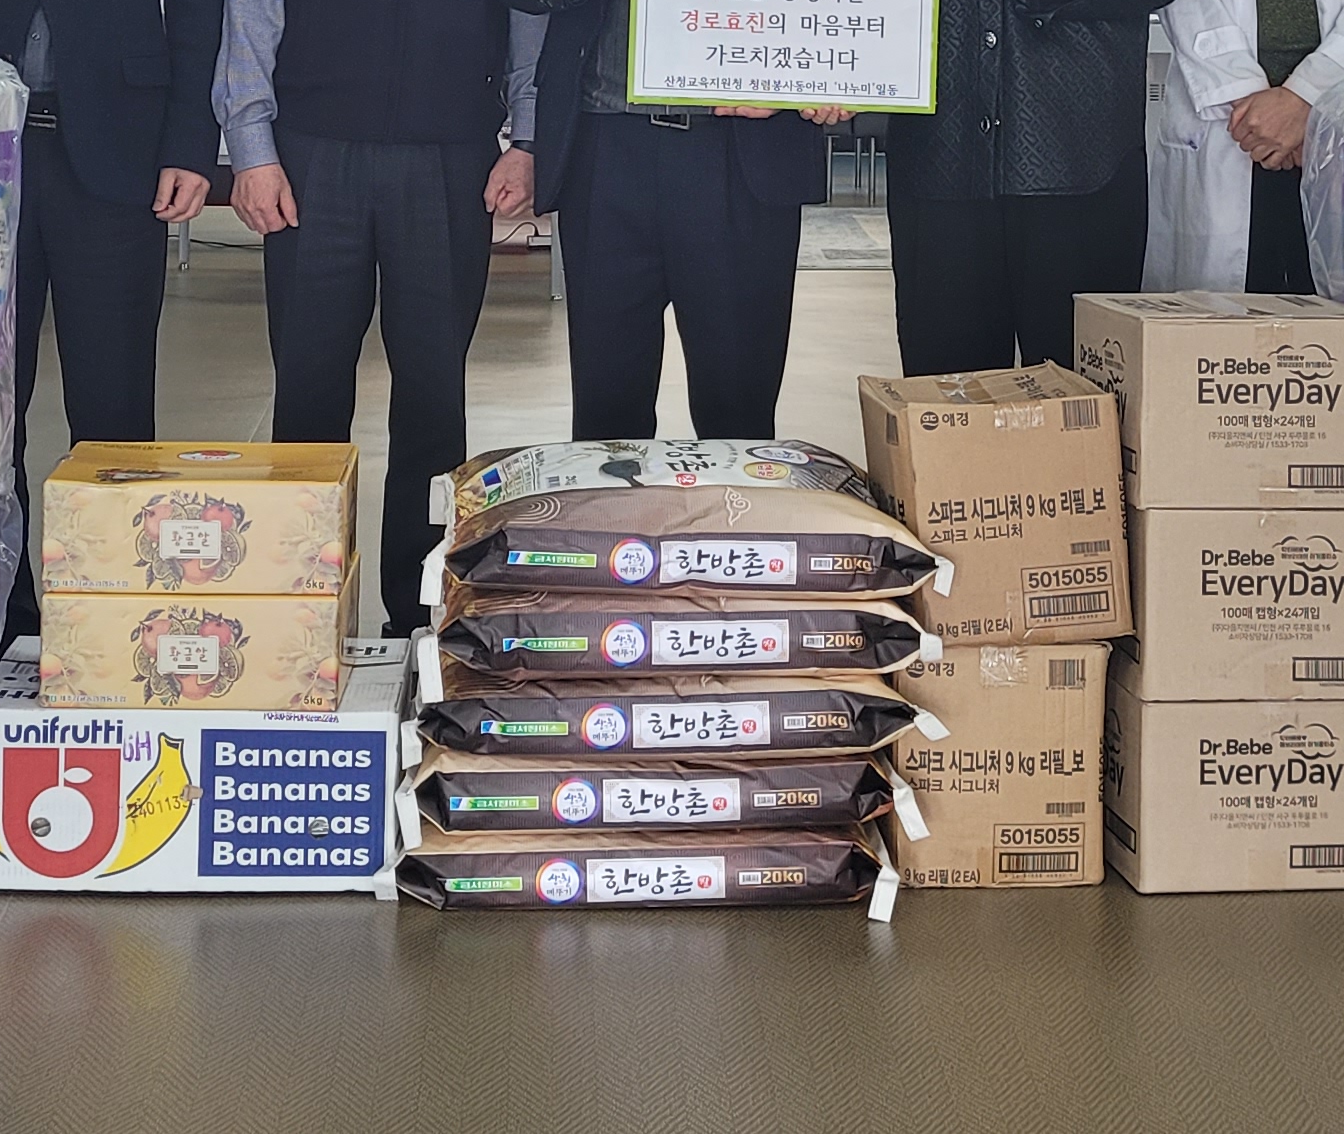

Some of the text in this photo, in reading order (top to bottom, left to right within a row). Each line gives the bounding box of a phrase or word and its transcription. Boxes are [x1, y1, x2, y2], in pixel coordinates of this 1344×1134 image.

[680, 9, 885, 38] 경로효친의 마음부터
[705, 44, 859, 71] 가르치겠습니다
[664, 75, 742, 89] 산청교육지원청
[749, 79, 827, 93] 청렴봉사동아리
[1197, 357, 1271, 376] Dr.Bebe
[1197, 377, 1343, 412] EveryDay
[941, 411, 969, 427] 애경
[1217, 416, 1249, 428] 100매
[927, 498, 967, 525] 스파크
[970, 493, 1023, 523] 시그니처
[1026, 494, 1035, 514] 9
[1038, 494, 1056, 519] kg
[1059, 487, 1106, 516] 리필_보
[171, 530, 210, 547] 황금알
[929, 522, 1023, 544] 스파크 시그니처
[675, 547, 765, 578] 한방촌
[833, 556, 873, 571] 20kg
[1201, 549, 1275, 567] Dr.Bebe
[305, 579, 324, 591] 5kg
[1027, 567, 1108, 590] 5015055
[1221, 606, 1253, 620] 100매
[936, 624, 944, 636] 9
[945, 622, 959, 638] kg
[961, 619, 982, 635] 리필
[666, 627, 758, 658] 한방촌
[825, 633, 864, 649] 20kg
[169, 646, 208, 662] 황금알
[928, 662, 955, 677] 애경
[303, 695, 322, 706] 5kg
[4, 716, 123, 744] unifrutti
[647, 709, 739, 741] 한방촌
[807, 714, 848, 729] 20kg
[214, 741, 372, 769] Bananas
[1199, 738, 1273, 756] Dr.Bebe
[906, 748, 945, 775] 스파크
[949, 748, 1001, 776] 시그니처
[1005, 751, 1014, 774] 9
[1018, 751, 1035, 776] kg
[1039, 748, 1085, 776] 리필_보
[1199, 758, 1344, 792] EveryDay
[213, 775, 371, 802] Bananas
[907, 777, 1000, 794] 스파크 시그니처
[617, 787, 709, 817] 한방촌
[777, 791, 818, 806] 20kg
[1219, 796, 1251, 809] 100매
[1000, 827, 1080, 845] 5015055
[212, 840, 370, 867] Bananas
[601, 864, 694, 895] 한방촌
[762, 870, 804, 884] 20kg
[905, 868, 911, 881] 9
[912, 868, 926, 884] kg
[927, 869, 949, 884] 리필
